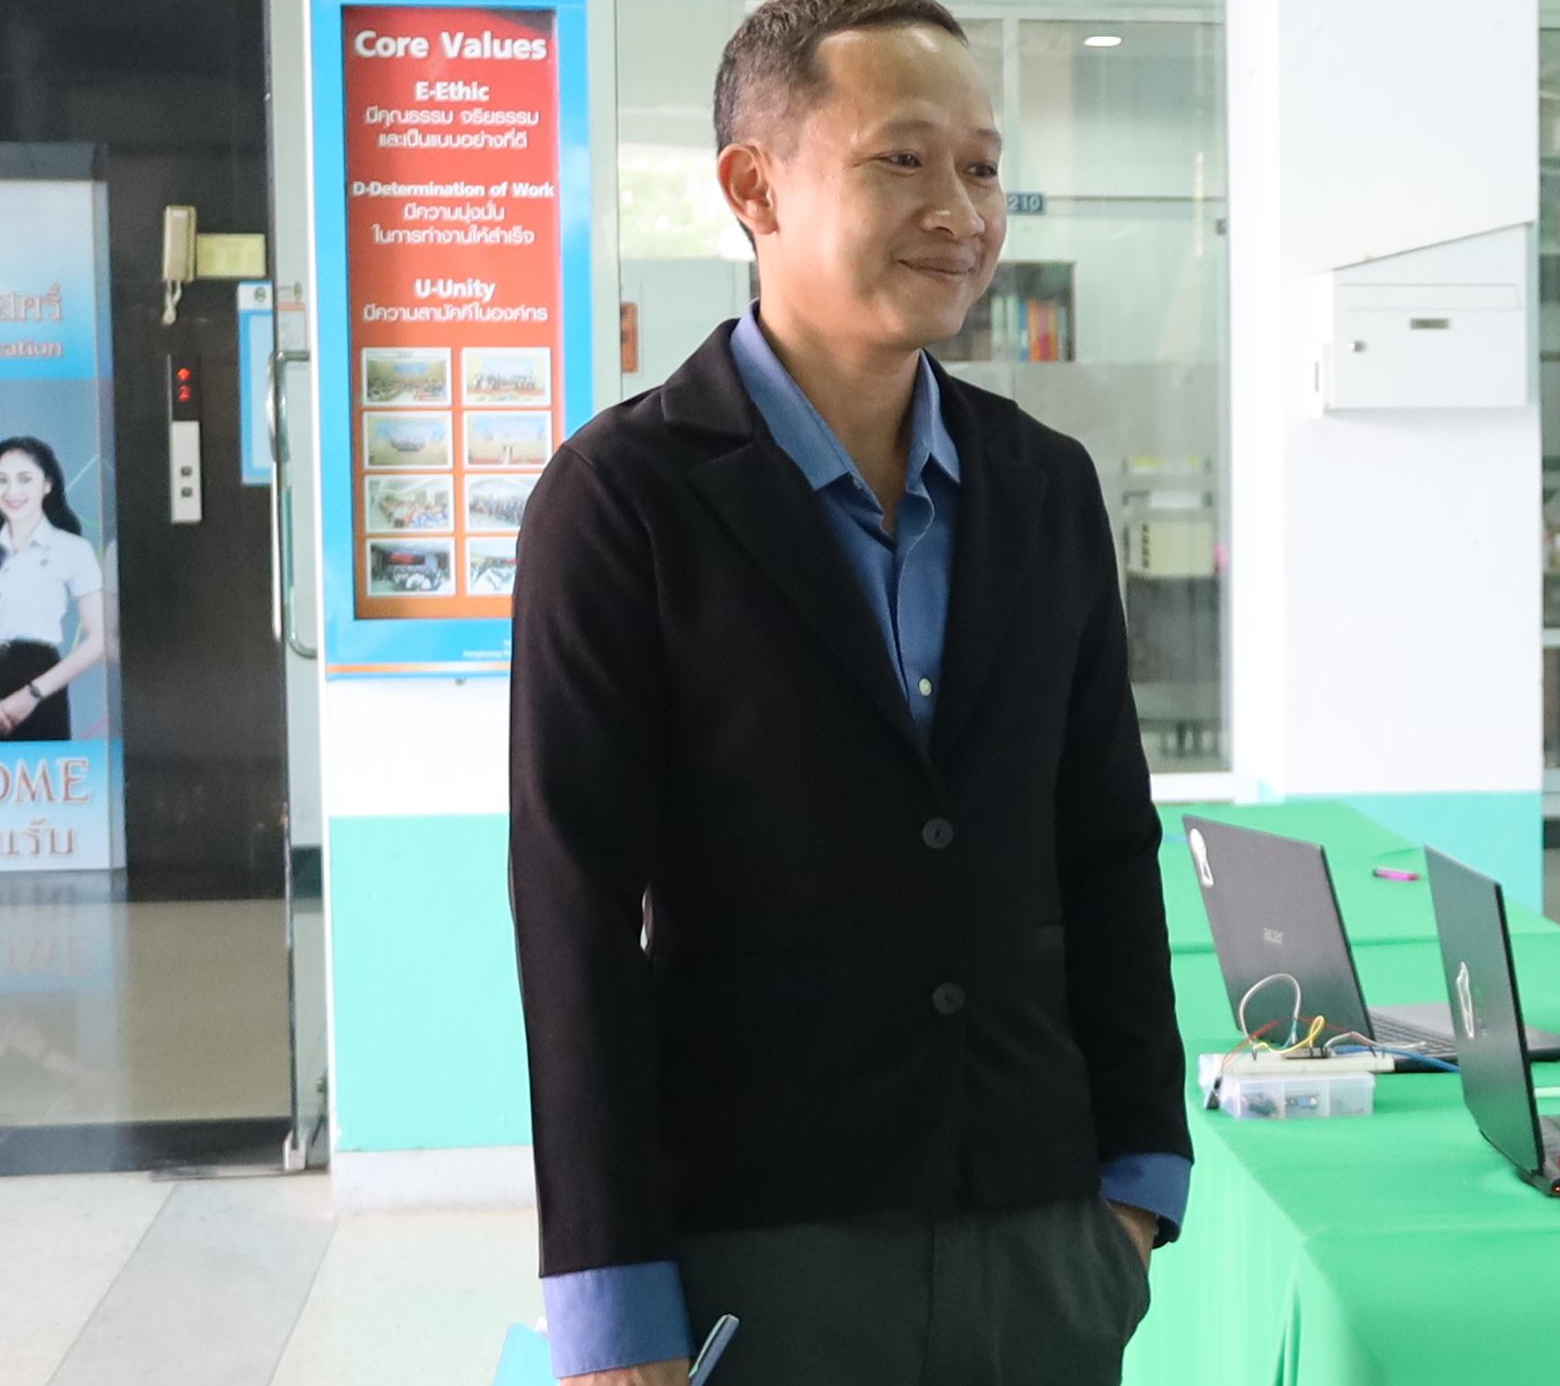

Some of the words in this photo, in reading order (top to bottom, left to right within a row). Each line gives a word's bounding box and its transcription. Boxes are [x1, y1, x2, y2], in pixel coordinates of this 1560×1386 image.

[354, 29, 429, 58] Core
[440, 30, 548, 61] Values
[414, 80, 490, 101] E-Ethic
[352, 181, 486, 198] D-Determination
[490, 181, 508, 198] of
[512, 182, 555, 198] Work
[414, 278, 496, 303] U-Unity
